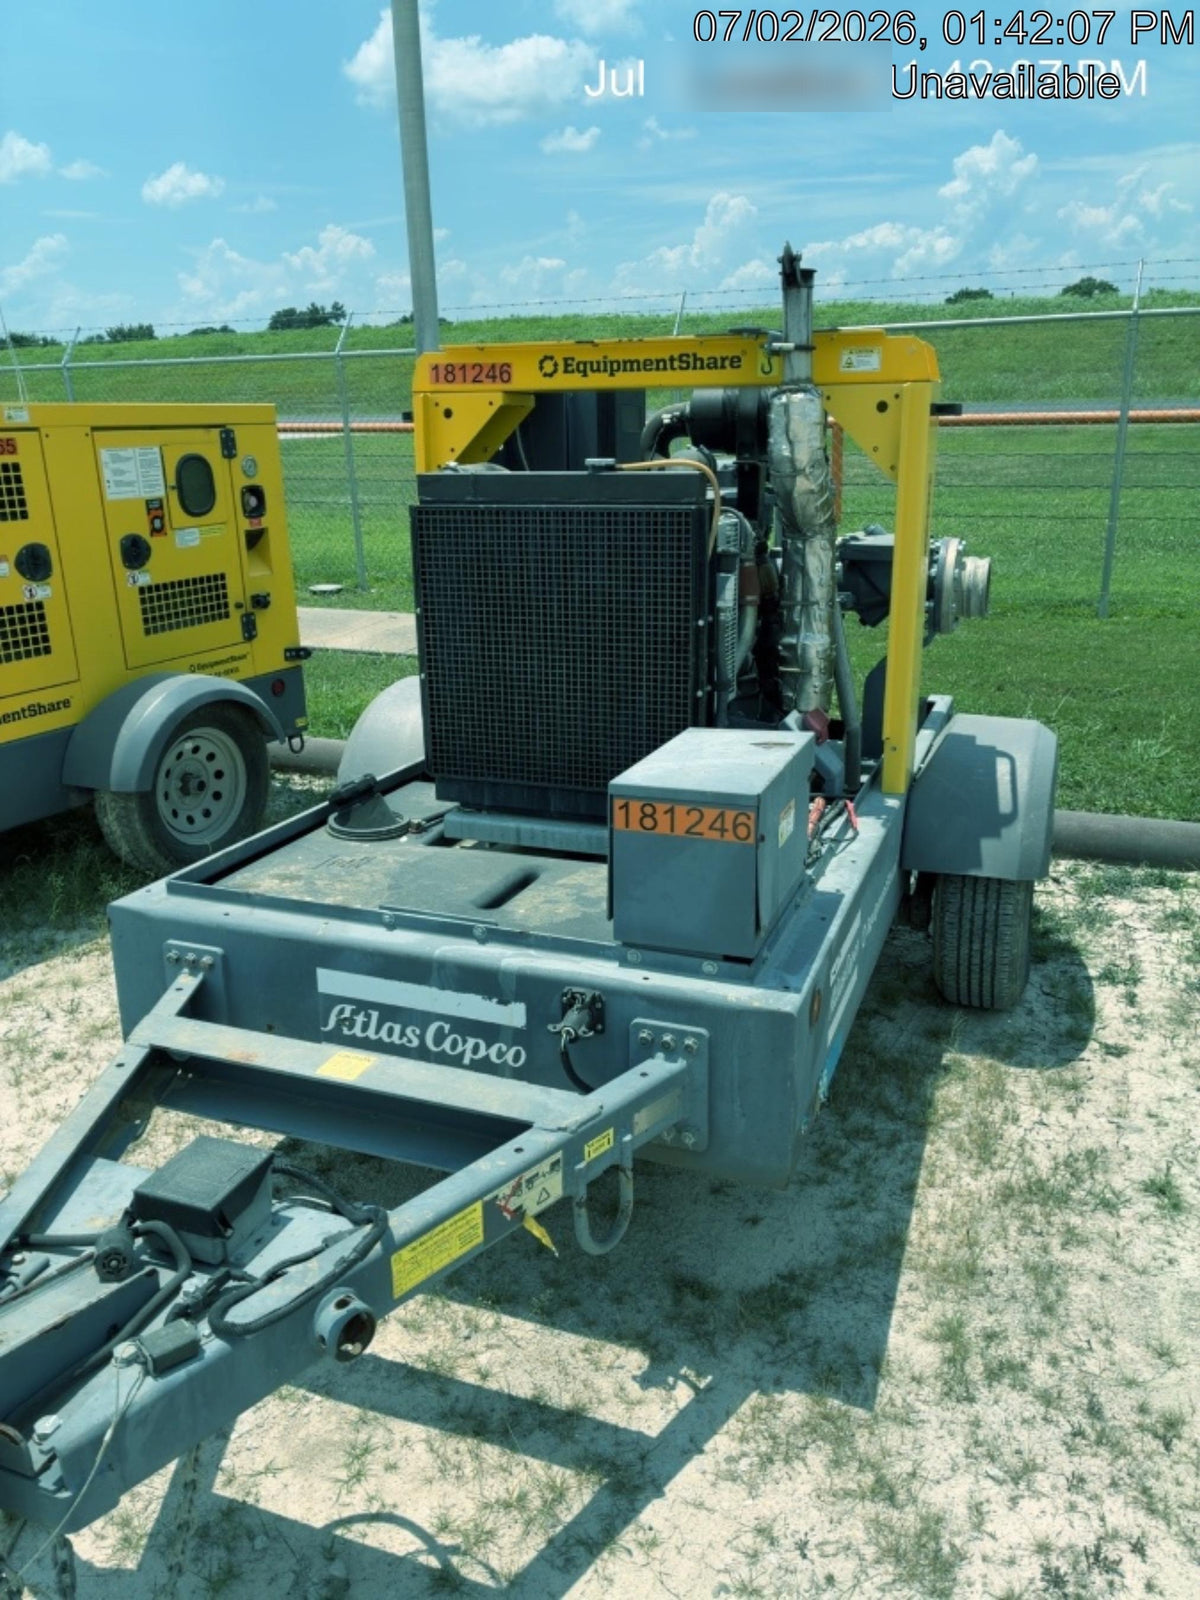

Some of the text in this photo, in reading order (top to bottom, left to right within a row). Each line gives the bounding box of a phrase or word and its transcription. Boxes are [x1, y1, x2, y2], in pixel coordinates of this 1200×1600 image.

[431, 362, 512, 384] 181246
[562, 352, 742, 378] EquipmentShare
[0, 697, 71, 725] entShare
[618, 801, 752, 842] 181246
[320, 1003, 526, 1067] Atlas Copco
